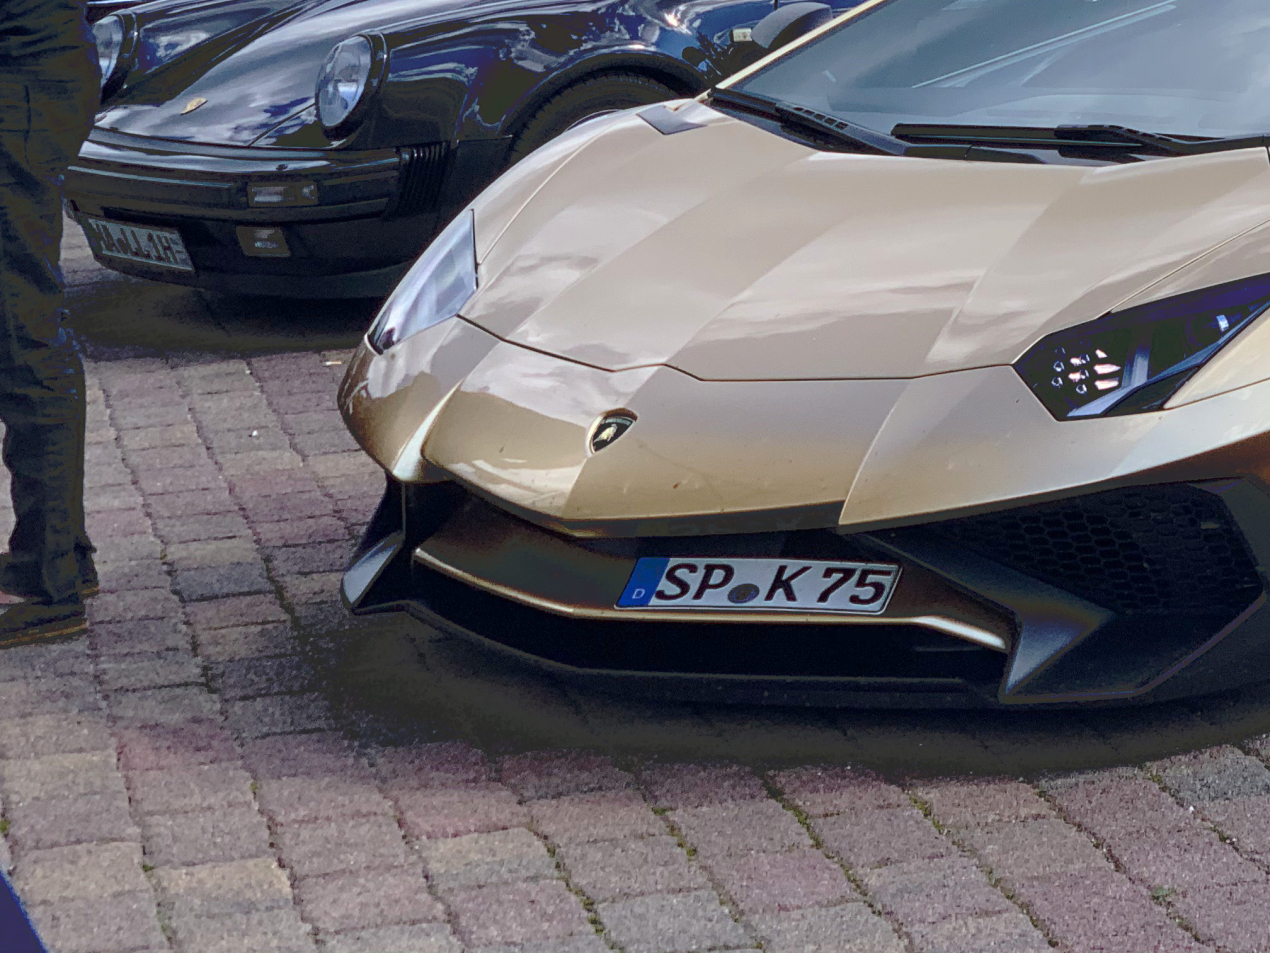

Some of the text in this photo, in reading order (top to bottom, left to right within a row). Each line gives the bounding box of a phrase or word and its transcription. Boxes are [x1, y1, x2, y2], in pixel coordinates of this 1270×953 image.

[632, 563, 892, 605] D SP K 75
